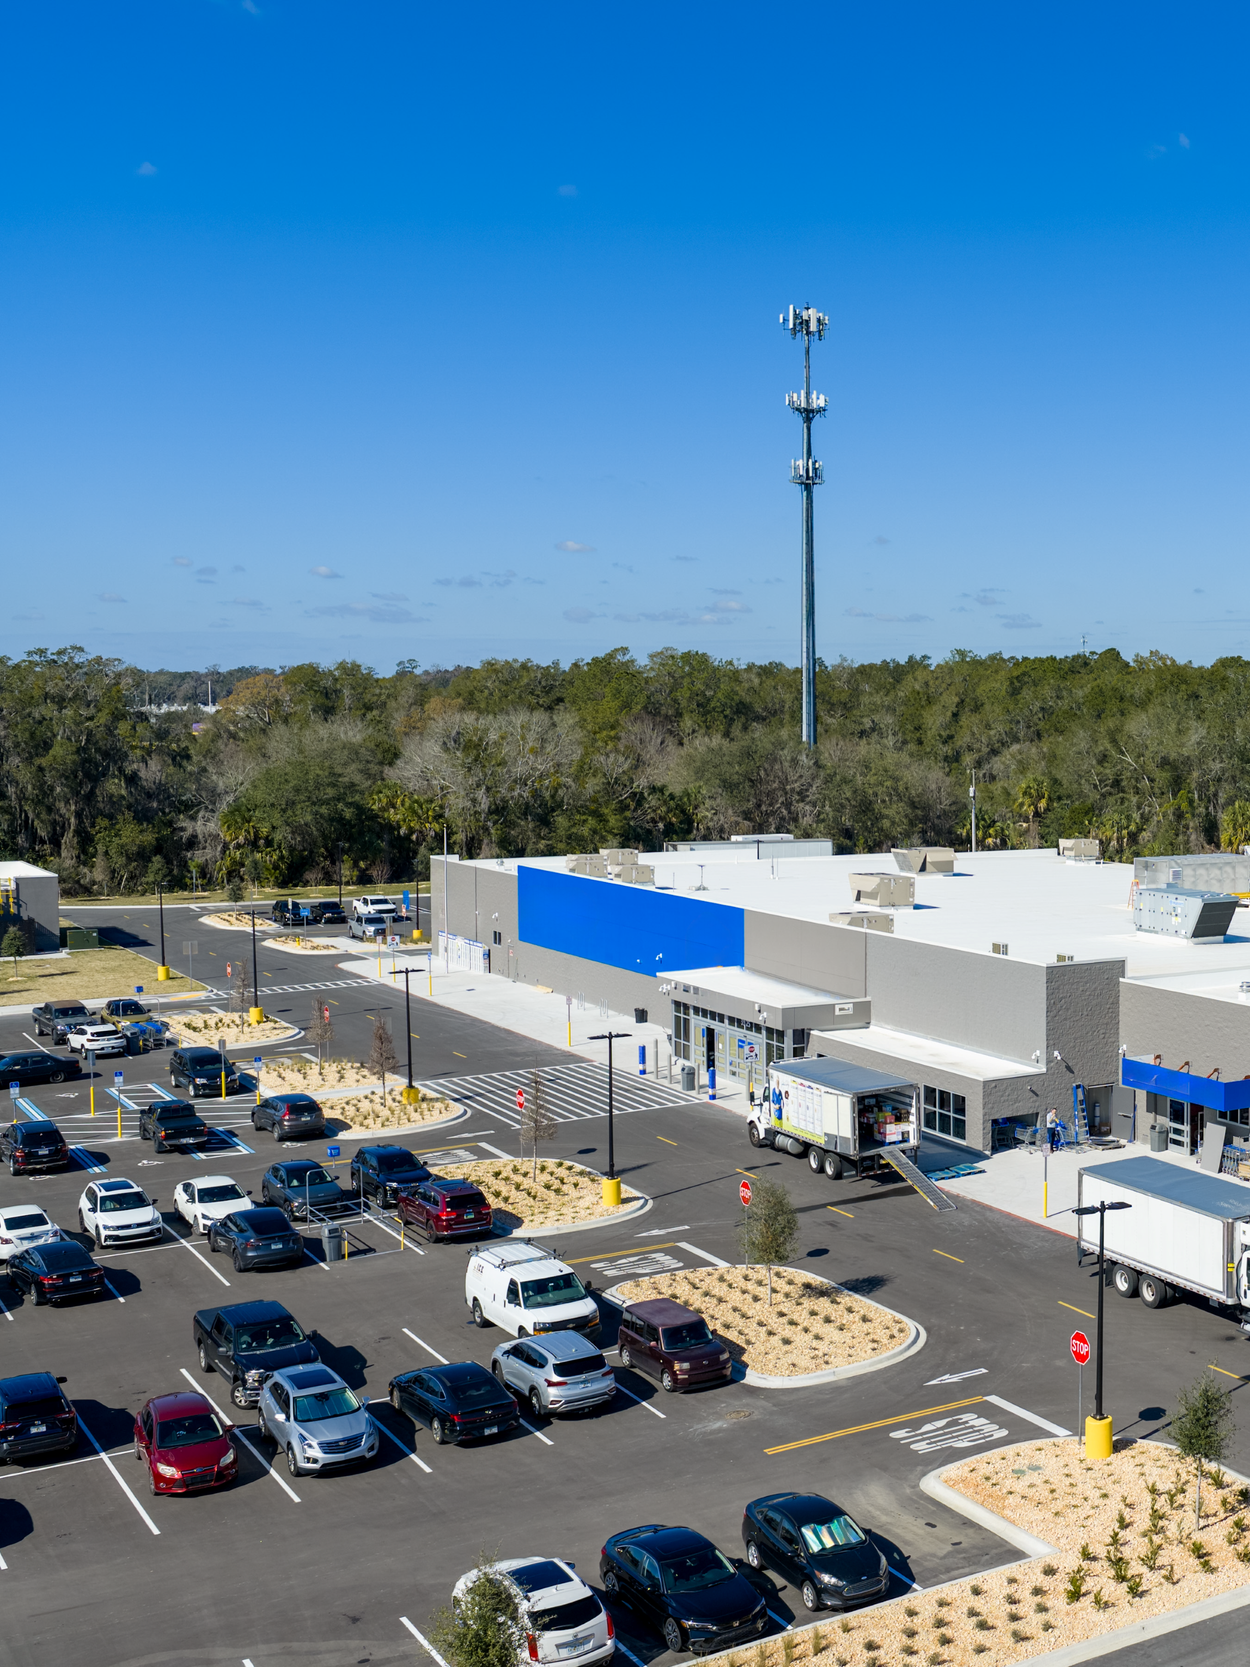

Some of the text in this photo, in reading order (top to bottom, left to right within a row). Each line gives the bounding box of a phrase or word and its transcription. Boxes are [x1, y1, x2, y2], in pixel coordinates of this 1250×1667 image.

[589, 1252, 684, 1277] STOP
[1072, 1339, 1089, 1355] STOP
[888, 1412, 1009, 1454] STOP
